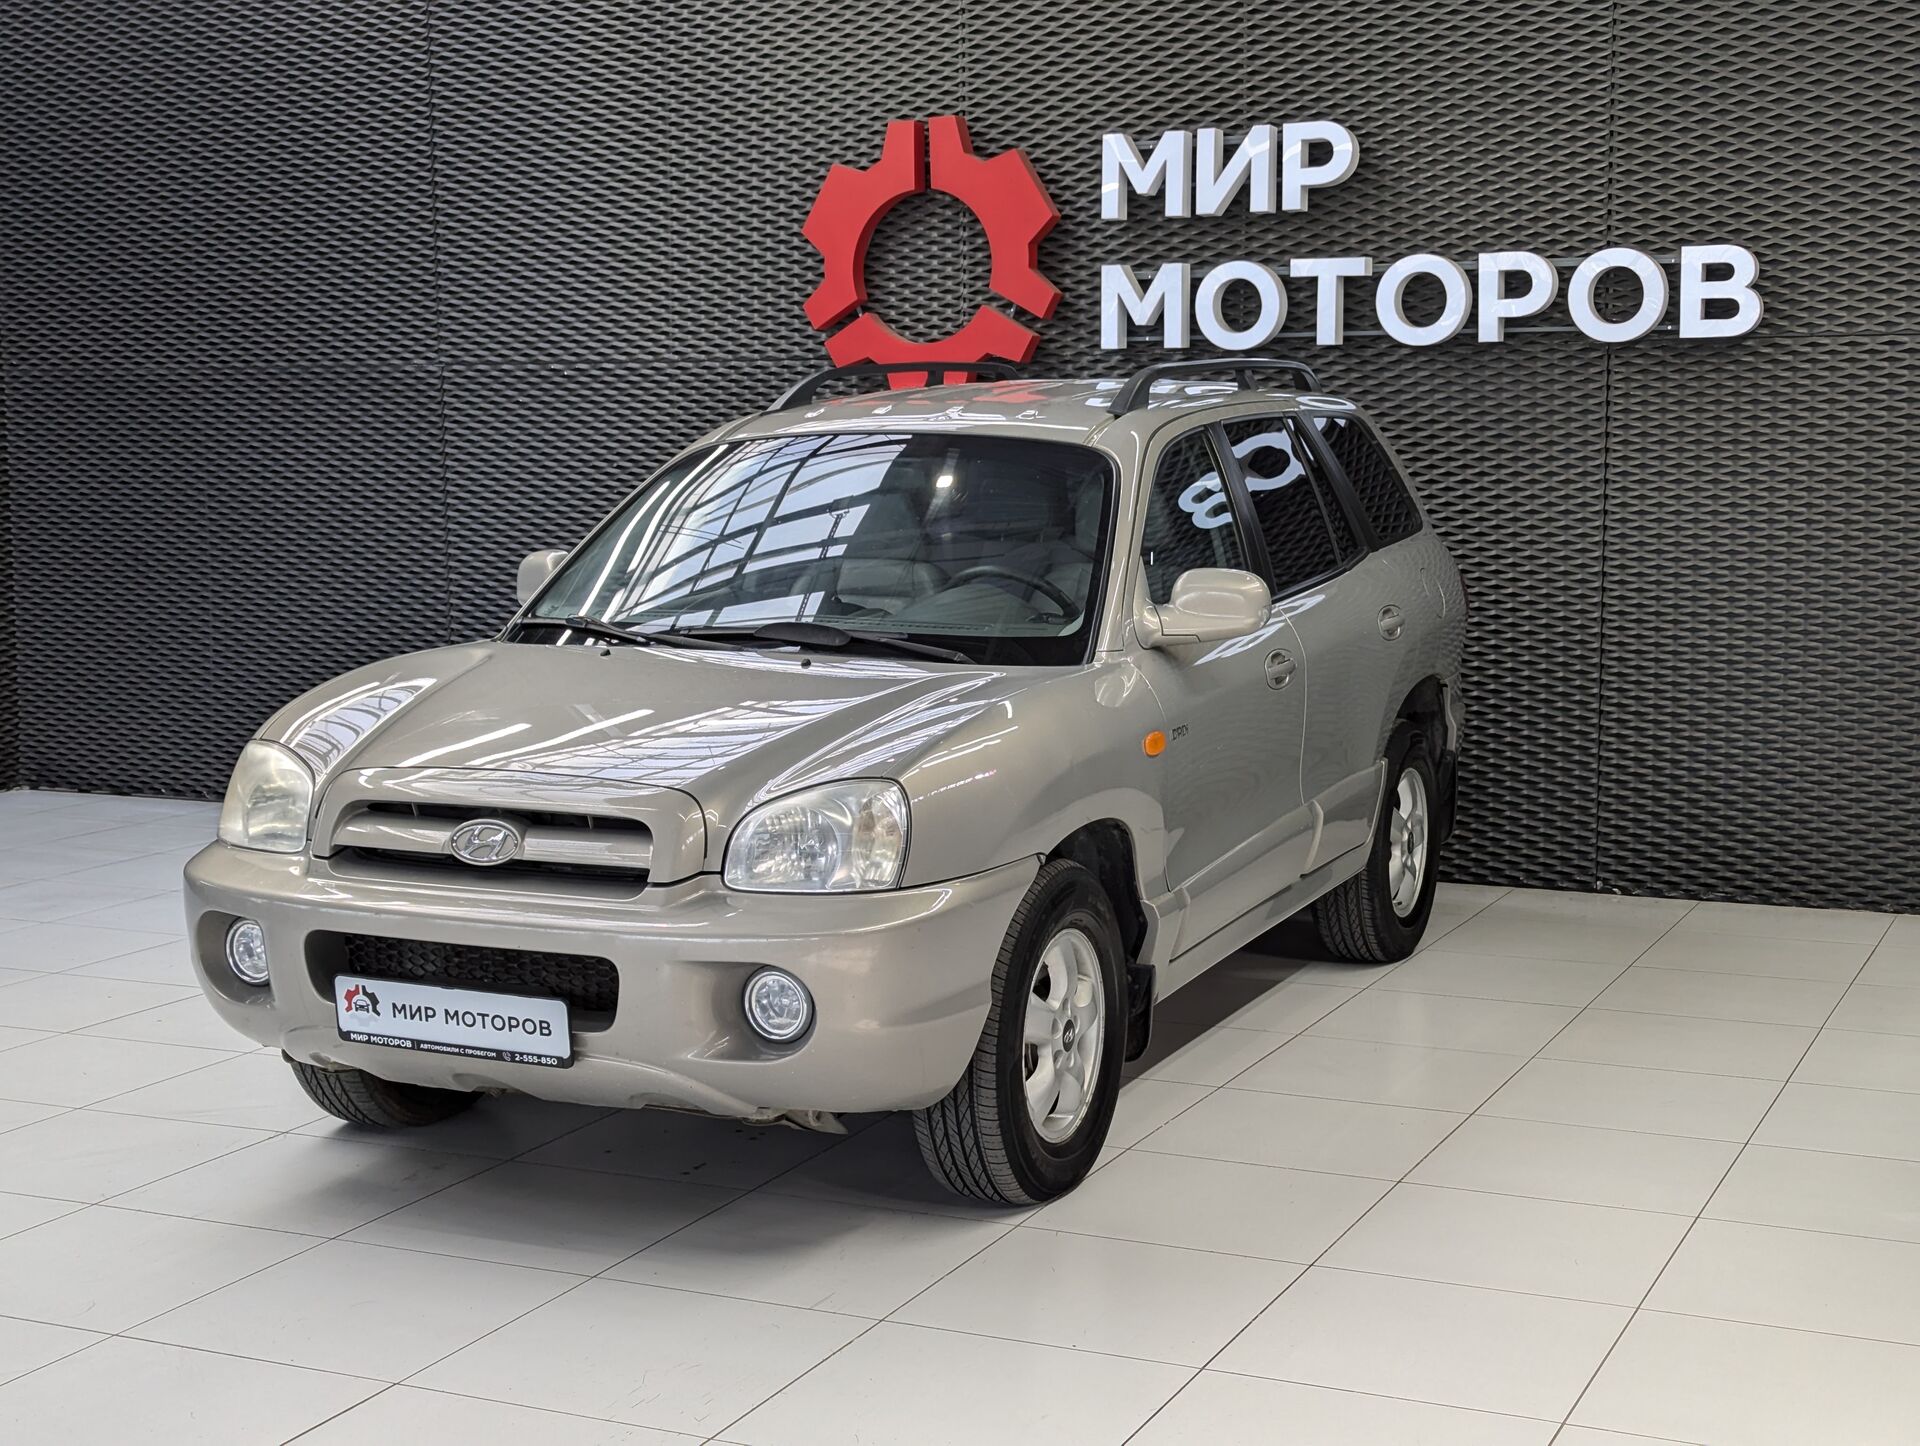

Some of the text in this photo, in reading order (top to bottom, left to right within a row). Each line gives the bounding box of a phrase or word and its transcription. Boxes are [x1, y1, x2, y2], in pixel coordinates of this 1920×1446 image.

[1101, 121, 1360, 220] МИР
[1100, 244, 1764, 350] МОТОРОВ
[350, 1033, 369, 1043] МИР
[370, 1035, 412, 1048] МОТОРОВ
[465, 1048, 497, 1058] ПРОБЕГОМ
[514, 1053, 558, 1066] 2-555-850
[391, 1002, 553, 1037] МИР МОТОРОВ
